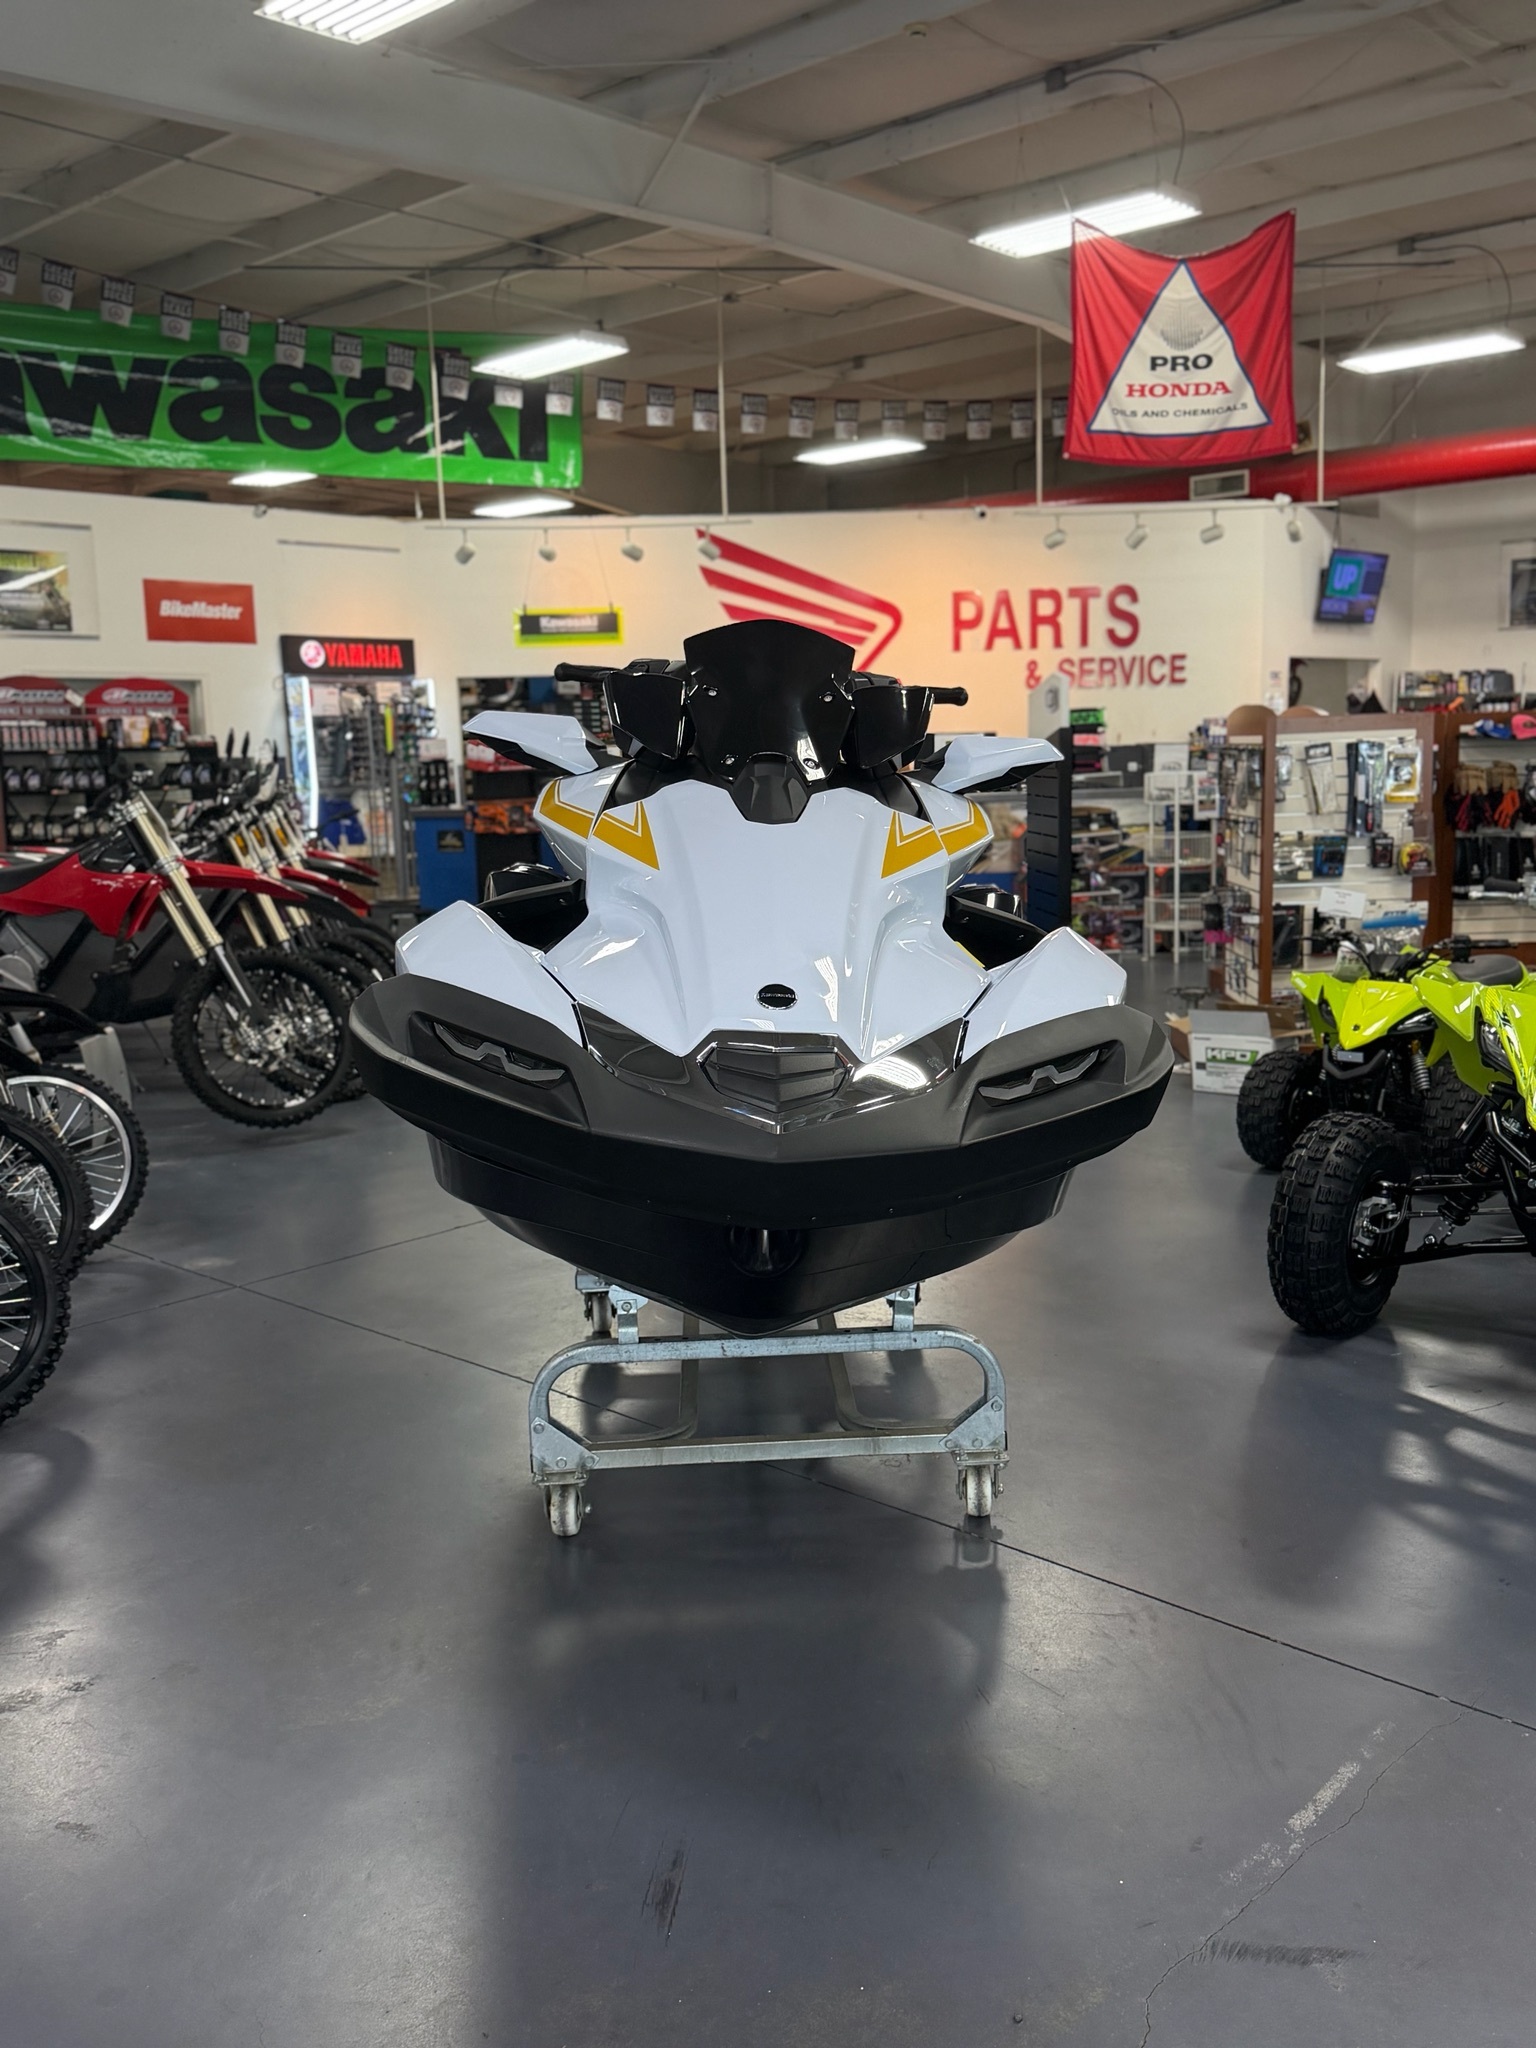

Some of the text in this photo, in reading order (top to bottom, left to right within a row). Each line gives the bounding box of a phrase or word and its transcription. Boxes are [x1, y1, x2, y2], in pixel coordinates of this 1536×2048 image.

[1150, 354, 1213, 371] PRO
[1125, 381, 1232, 398] HONDA
[1112, 402, 1248, 418] OILS AND CHEMICALS
[159, 599, 243, 621] BikeMaster
[952, 584, 1140, 651] PARTS
[324, 642, 404, 669] YAMAHA
[1026, 654, 1187, 689] & SERVICE
